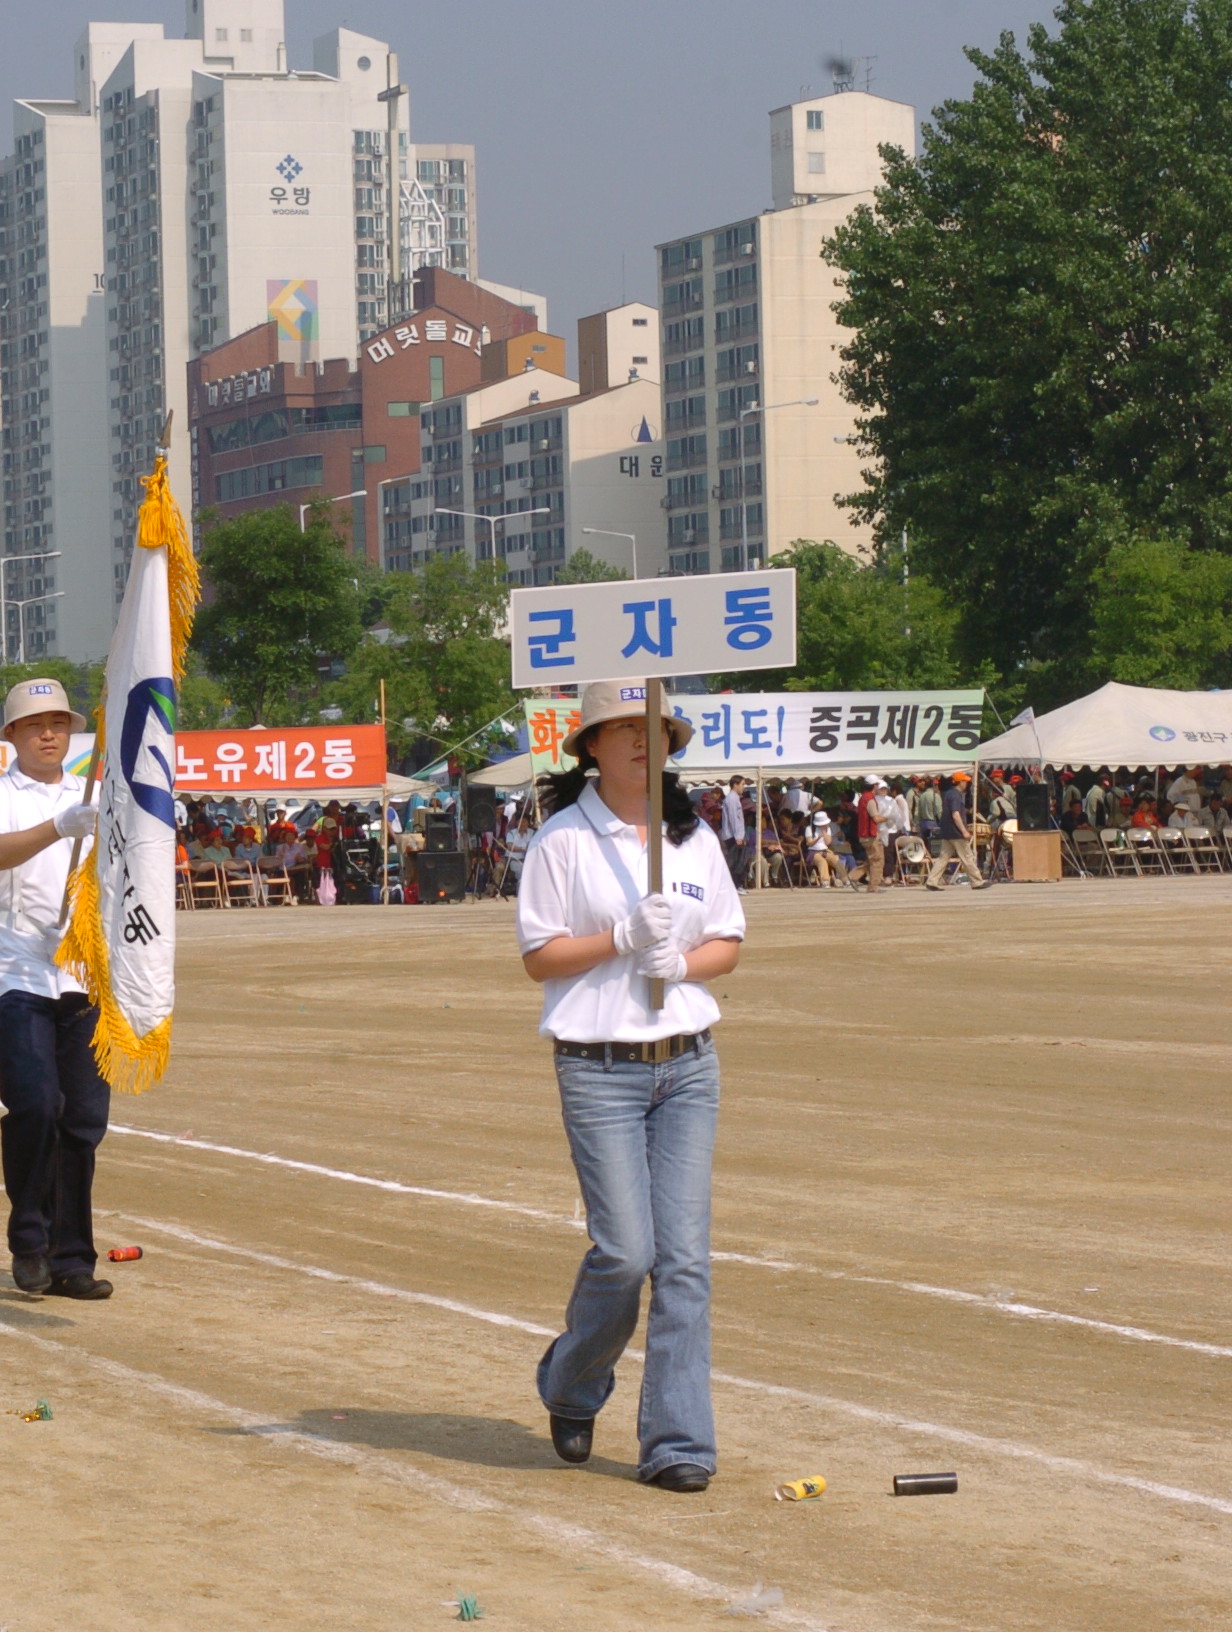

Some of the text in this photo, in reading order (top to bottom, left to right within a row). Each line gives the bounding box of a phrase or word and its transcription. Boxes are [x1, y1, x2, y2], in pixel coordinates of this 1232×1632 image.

[269, 186, 311, 206] 우방
[528, 587, 773, 668] 군자동
[809, 705, 983, 752] 중곡제2동
[176, 739, 356, 783] 노유제2동
